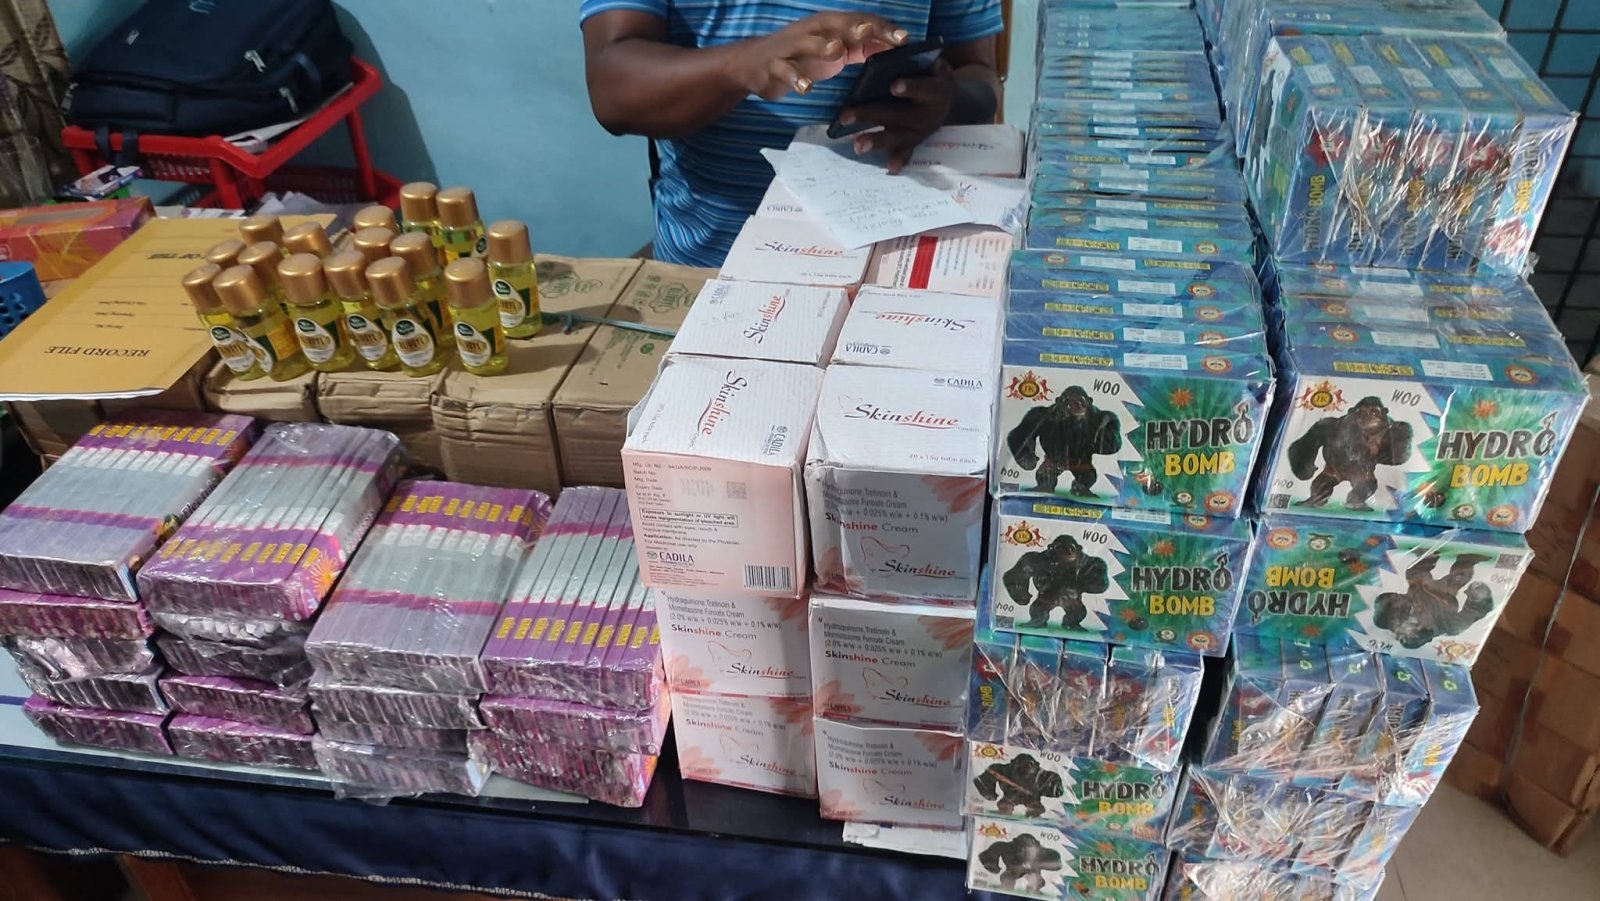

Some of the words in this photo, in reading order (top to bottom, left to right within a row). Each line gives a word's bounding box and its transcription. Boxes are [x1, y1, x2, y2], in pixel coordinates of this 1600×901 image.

[1309, 175, 1325, 208] BOMB
[762, 241, 843, 257] Skinshine
[744, 295, 783, 344] Skinshine
[876, 313, 966, 331] Skinshine
[45, 346, 80, 354] FILE
[83, 348, 151, 357] RECORD
[846, 343, 878, 354] CADILA
[947, 378, 982, 388] CADILA
[1093, 378, 1120, 396] WOO
[700, 369, 747, 435] Skinshine
[1391, 389, 1421, 406] WOO
[849, 404, 959, 428] Skinshine
[1146, 411, 1254, 450] HYDRO
[768, 434, 786, 456] CADILA
[1436, 421, 1556, 460] HYDRO
[1164, 451, 1236, 476] BOMB
[1450, 463, 1530, 488] BOMB
[893, 490, 898, 498] &
[886, 499, 907, 508] Cream
[863, 508, 888, 518] 0.025%
[826, 512, 878, 532] Skinshine
[882, 522, 918, 534] Cream
[1082, 529, 1108, 545] WOO
[660, 552, 694, 562] CADILA
[881, 559, 956, 577] Skinshine
[1131, 560, 1233, 592] HYDRO
[1266, 565, 1336, 588] BOMB
[1149, 596, 1216, 616] BOMB
[1247, 590, 1352, 620] HYDRO
[708, 617, 728, 626] 0.025%
[726, 610, 744, 618] Cream
[671, 624, 721, 636] Skinshine
[724, 630, 757, 640] Cream
[886, 637, 904, 646] Cream
[825, 650, 878, 664] Skinshine
[882, 657, 916, 668] Cream
[729, 662, 794, 677] Skinshine
[882, 689, 950, 706] Skinshine
[980, 686, 994, 708] BOMB
[686, 718, 732, 731] Skinshine
[735, 726, 764, 736] Cream
[738, 754, 797, 773] Skinshine
[1040, 752, 1061, 762] WOO
[829, 761, 877, 774] Skinshine
[881, 768, 912, 776] Cream
[1082, 777, 1168, 800] HYDRO
[883, 796, 945, 809] Skinshine
[1098, 801, 1154, 816] BOMB
[1040, 831, 1060, 842] WOO
[1080, 855, 1160, 876] HYDRO
[1096, 874, 1148, 890] BOMB
